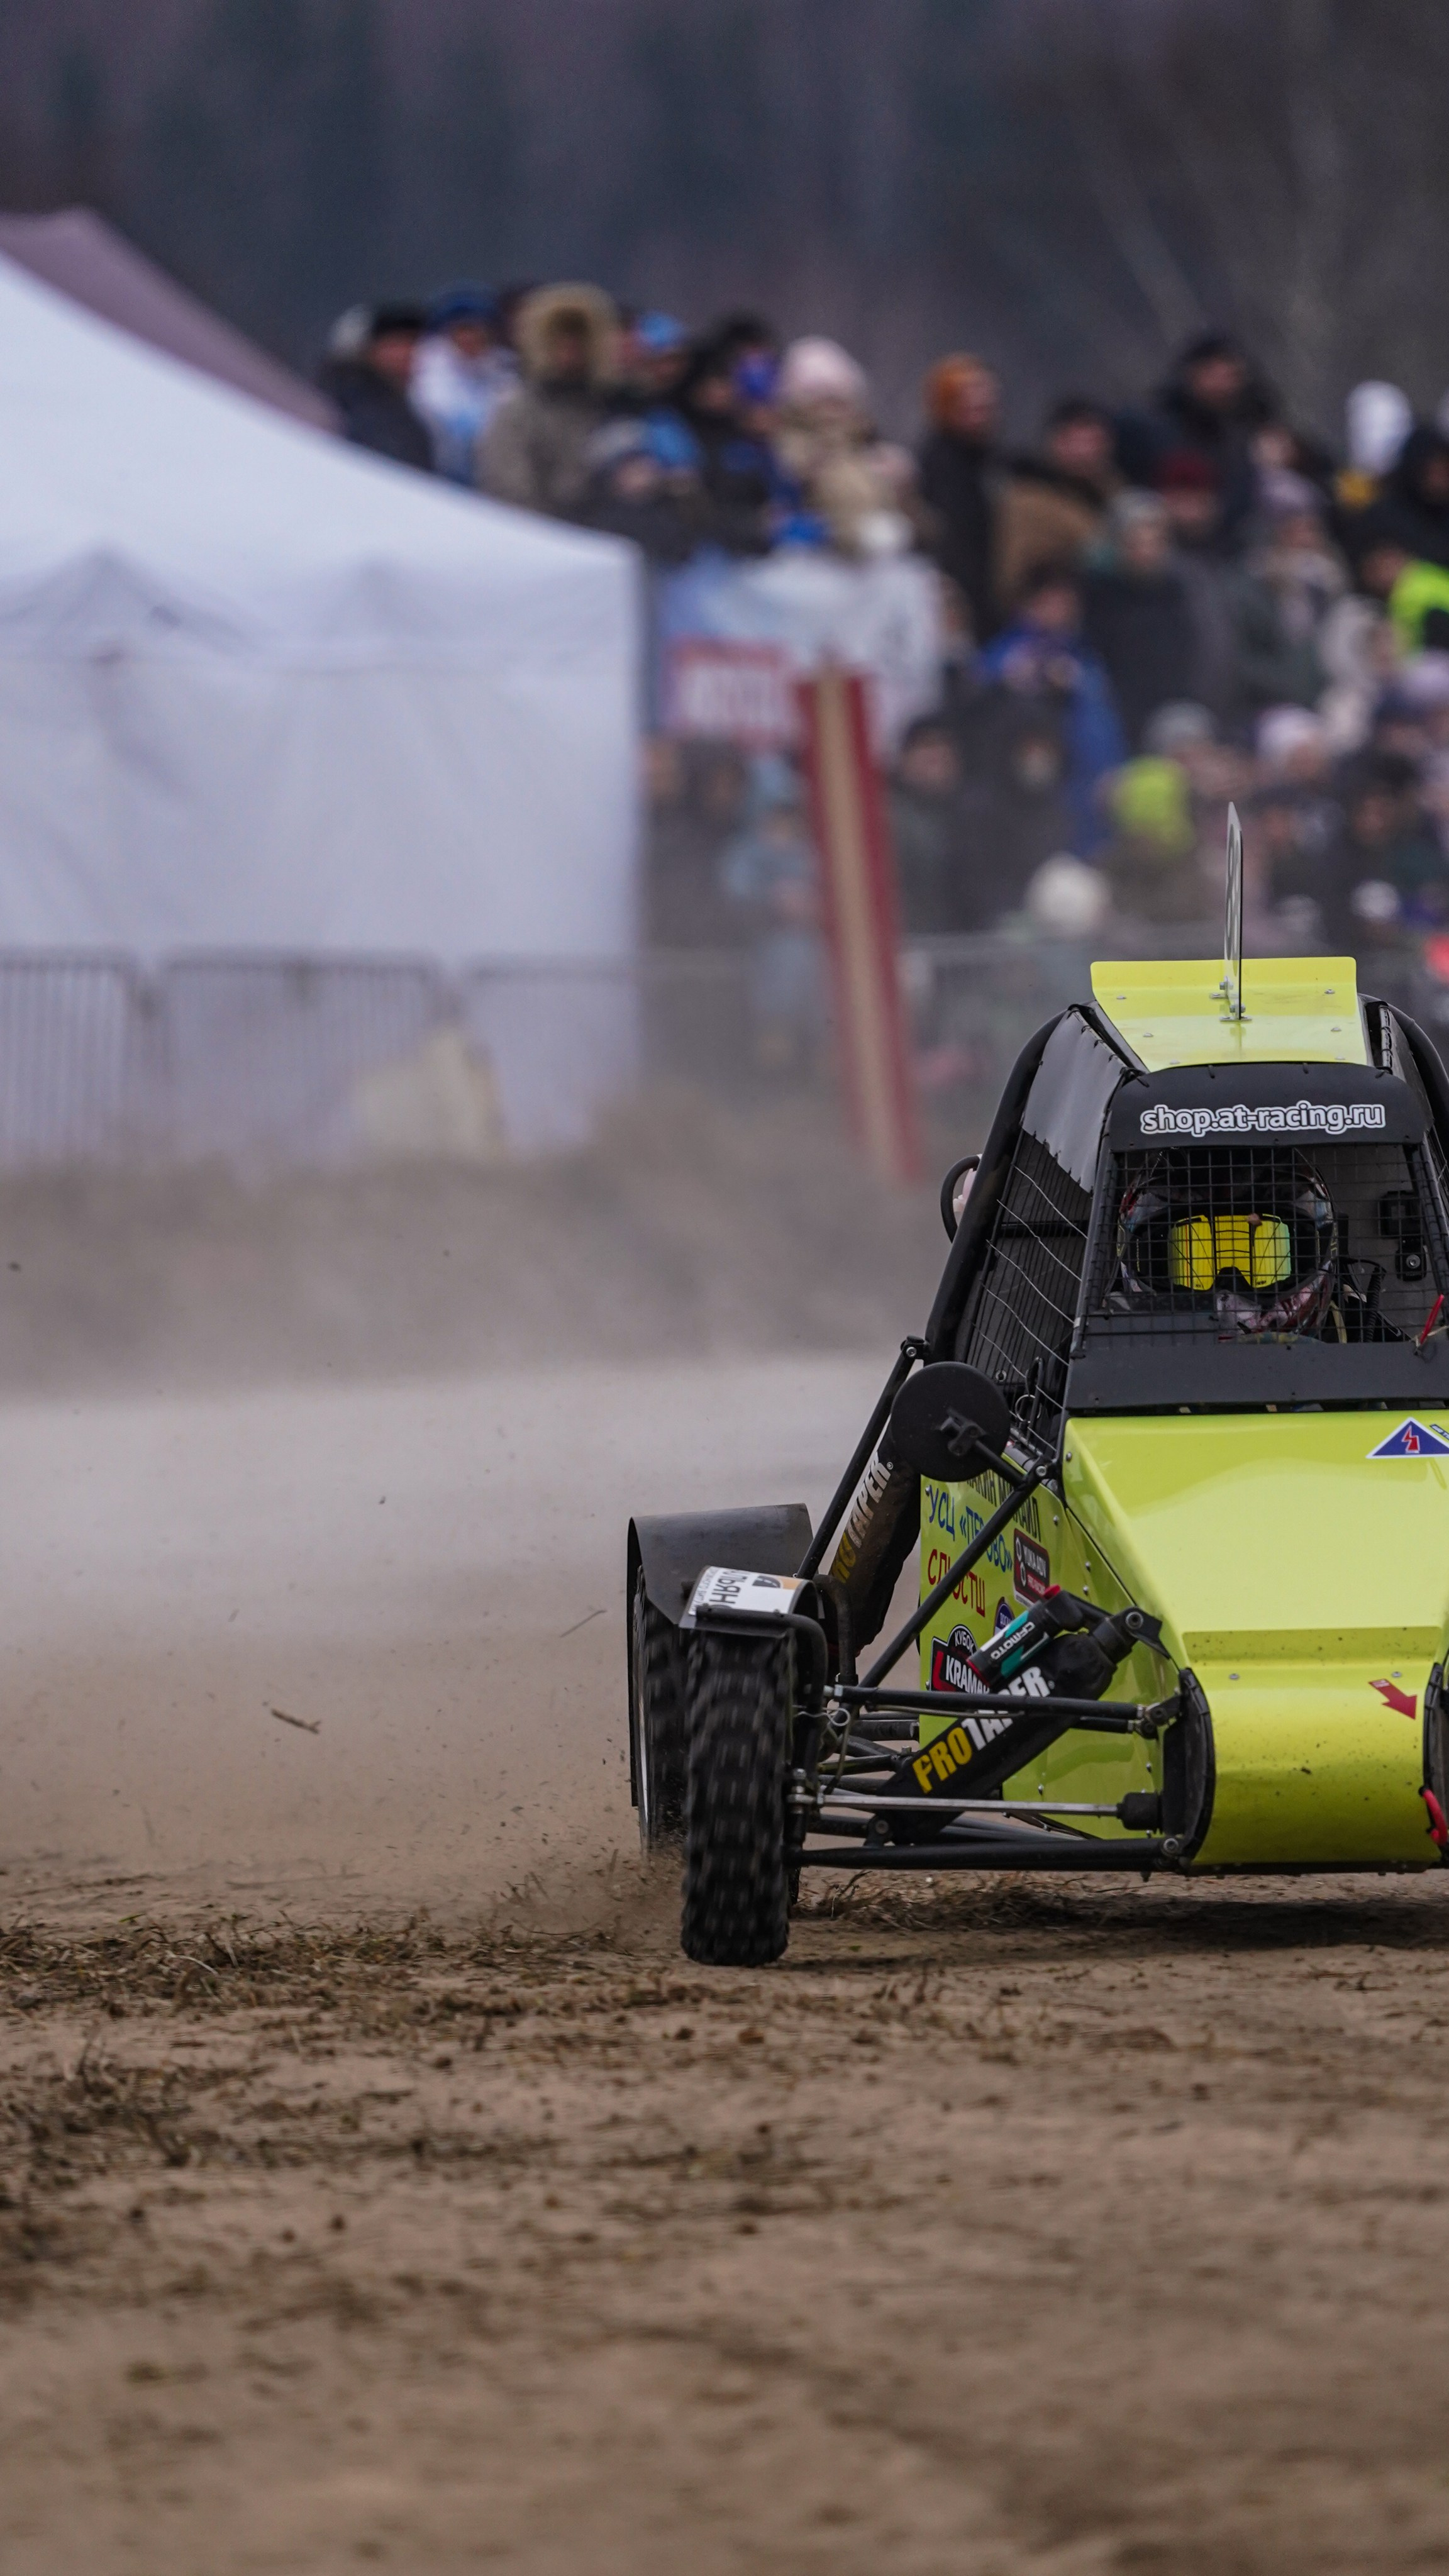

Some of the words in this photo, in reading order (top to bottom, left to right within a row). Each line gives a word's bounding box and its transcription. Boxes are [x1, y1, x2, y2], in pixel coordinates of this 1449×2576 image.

[1141, 1101, 1385, 1137] shop.at-racing.ru
[928, 1484, 955, 1542] УСЦ
[954, 1630, 975, 1657] КУБОК
[990, 1621, 1036, 1660] CFMOTO
